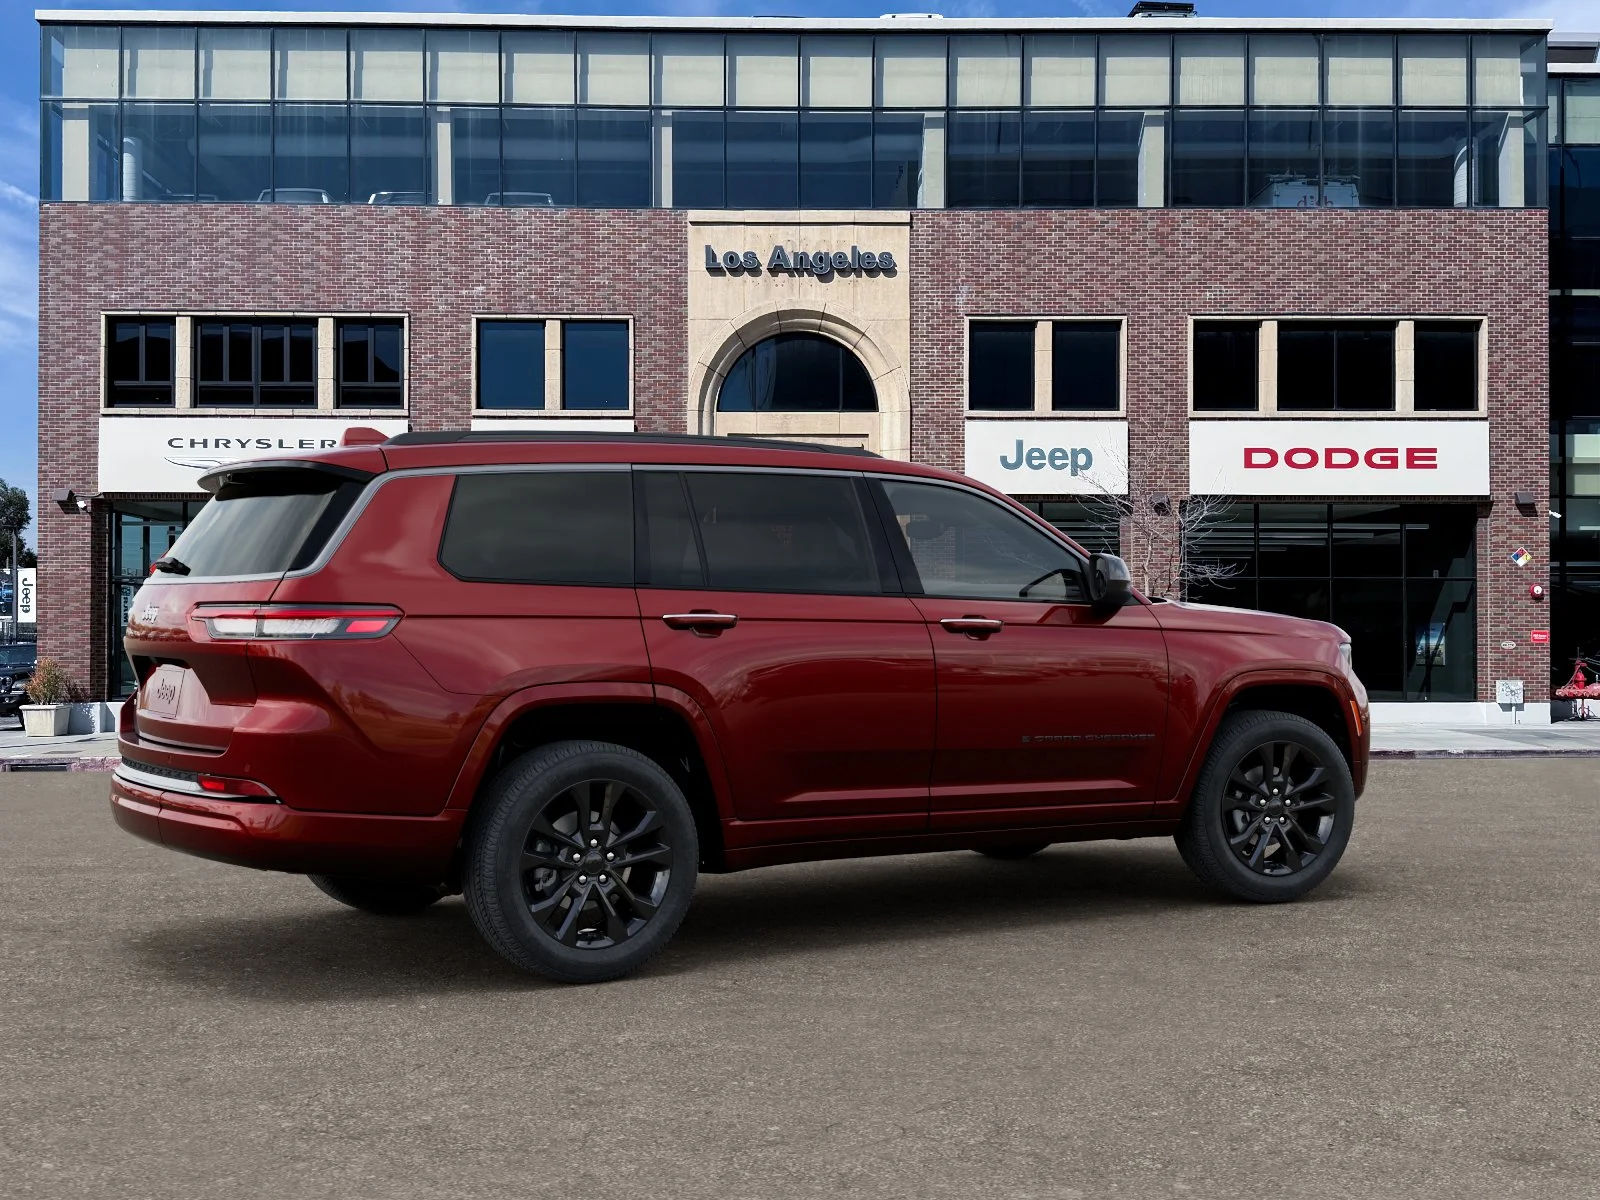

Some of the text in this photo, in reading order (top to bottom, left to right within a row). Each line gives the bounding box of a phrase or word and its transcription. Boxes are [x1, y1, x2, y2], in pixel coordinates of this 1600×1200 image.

[705, 244, 895, 275] Los Angeles
[167, 437, 337, 449] CHRYSLER
[999, 438, 1094, 477] Jeep
[1243, 447, 1438, 470] DODGE
[19, 577, 34, 614] Jeep
